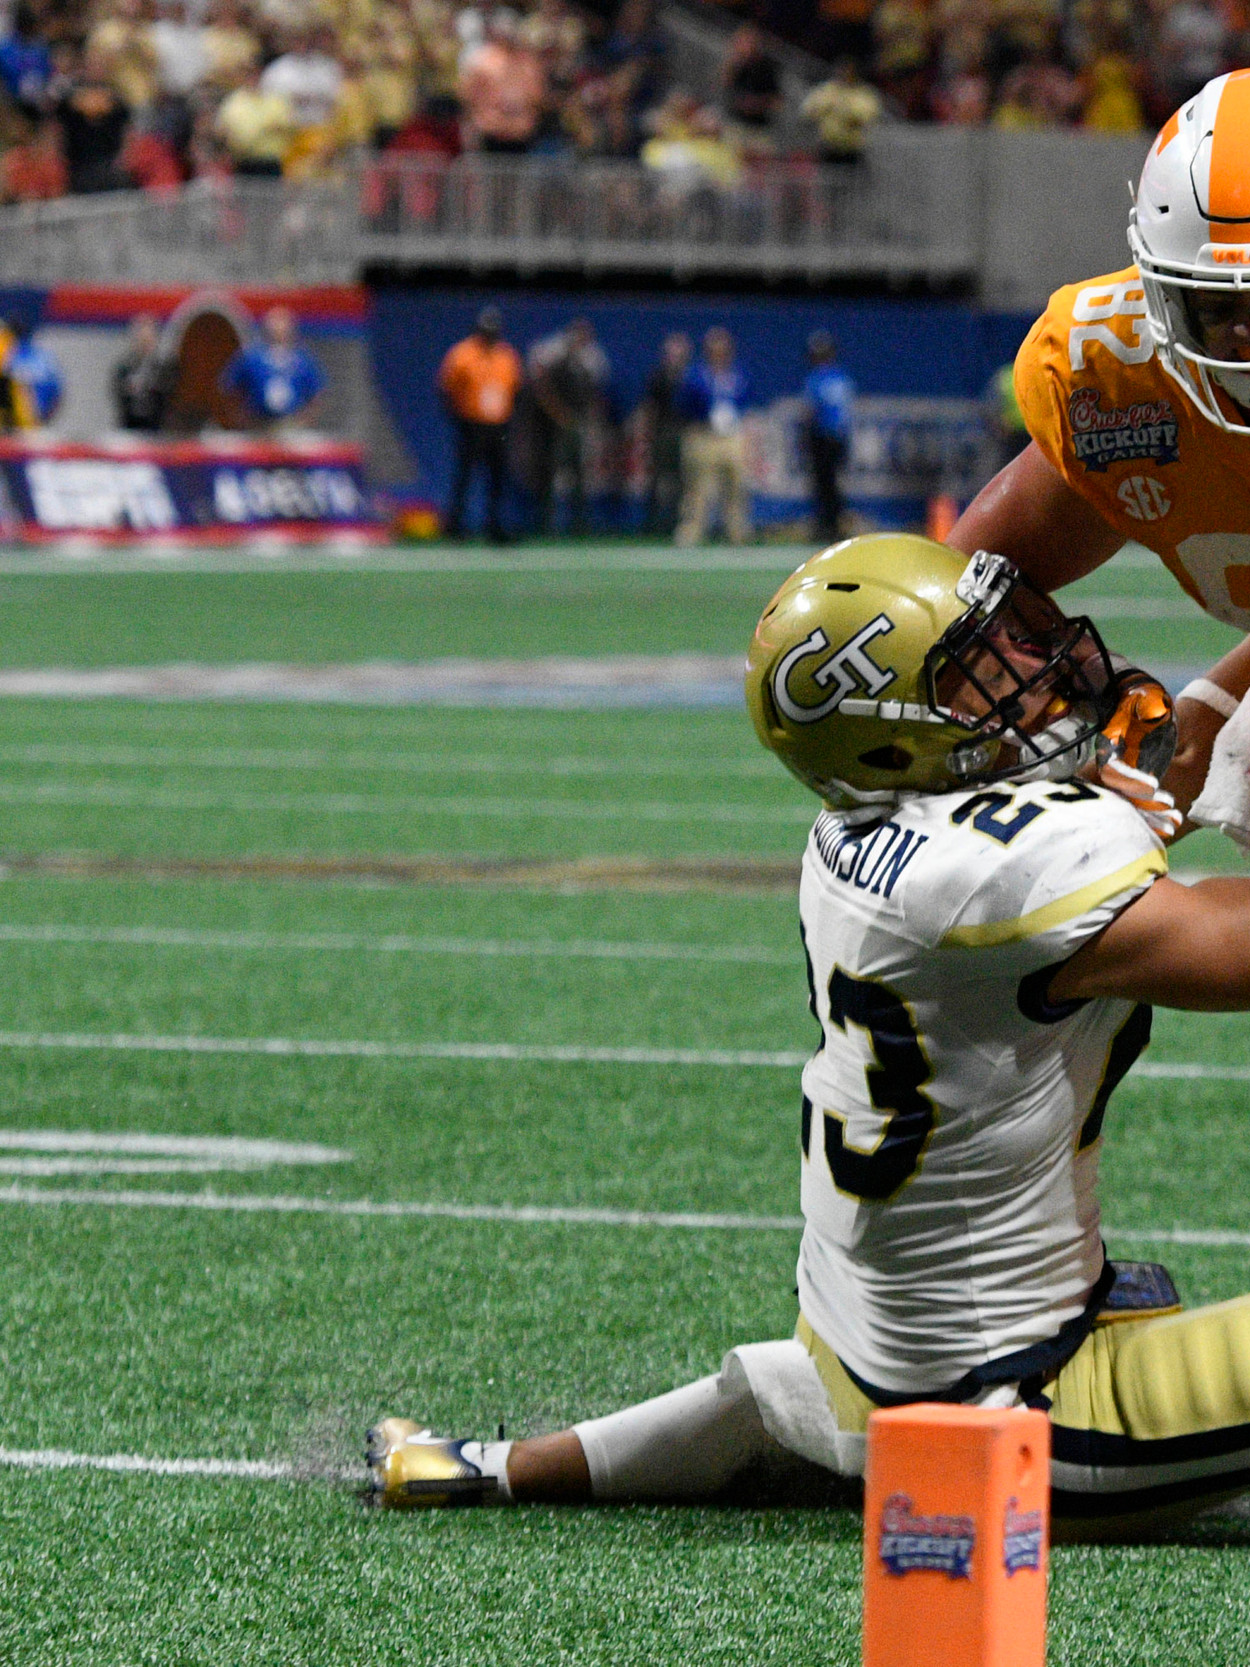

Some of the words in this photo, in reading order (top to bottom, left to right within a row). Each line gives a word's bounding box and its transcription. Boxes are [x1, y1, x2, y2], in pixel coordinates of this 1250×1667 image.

[1069, 279, 1155, 371] 82
[1073, 423, 1177, 458] KICKOFF
[1098, 447, 1163, 464] GAME
[1117, 476, 1171, 520] SEC
[773, 612, 897, 723] GT
